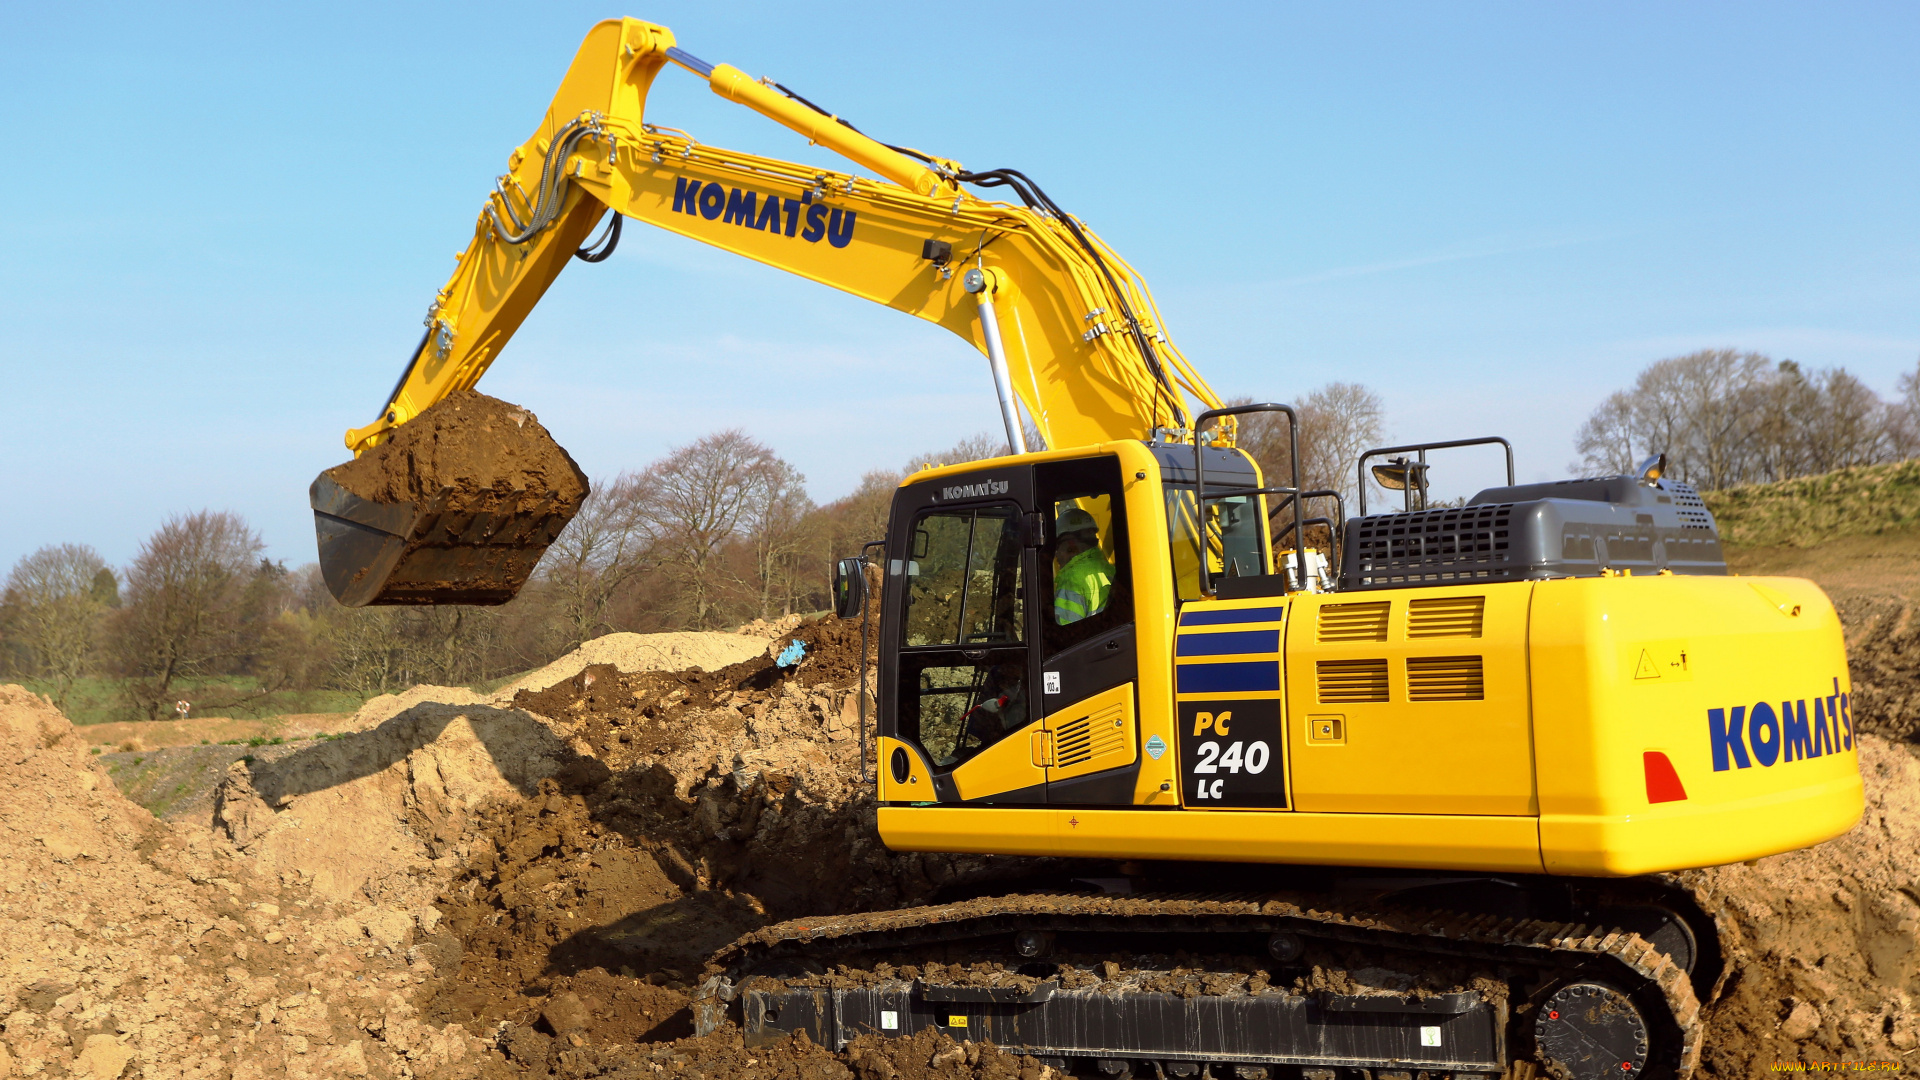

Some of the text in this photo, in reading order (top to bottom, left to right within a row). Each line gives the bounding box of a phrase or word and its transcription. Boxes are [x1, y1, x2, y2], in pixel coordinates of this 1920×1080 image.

[672, 177, 857, 249] KOMATSU
[943, 479, 1008, 500] KOMATSU
[1193, 711, 1232, 736] PC
[1707, 676, 1857, 772] KOMATS
[1193, 740, 1270, 774] 240
[1197, 779, 1224, 799] LC
